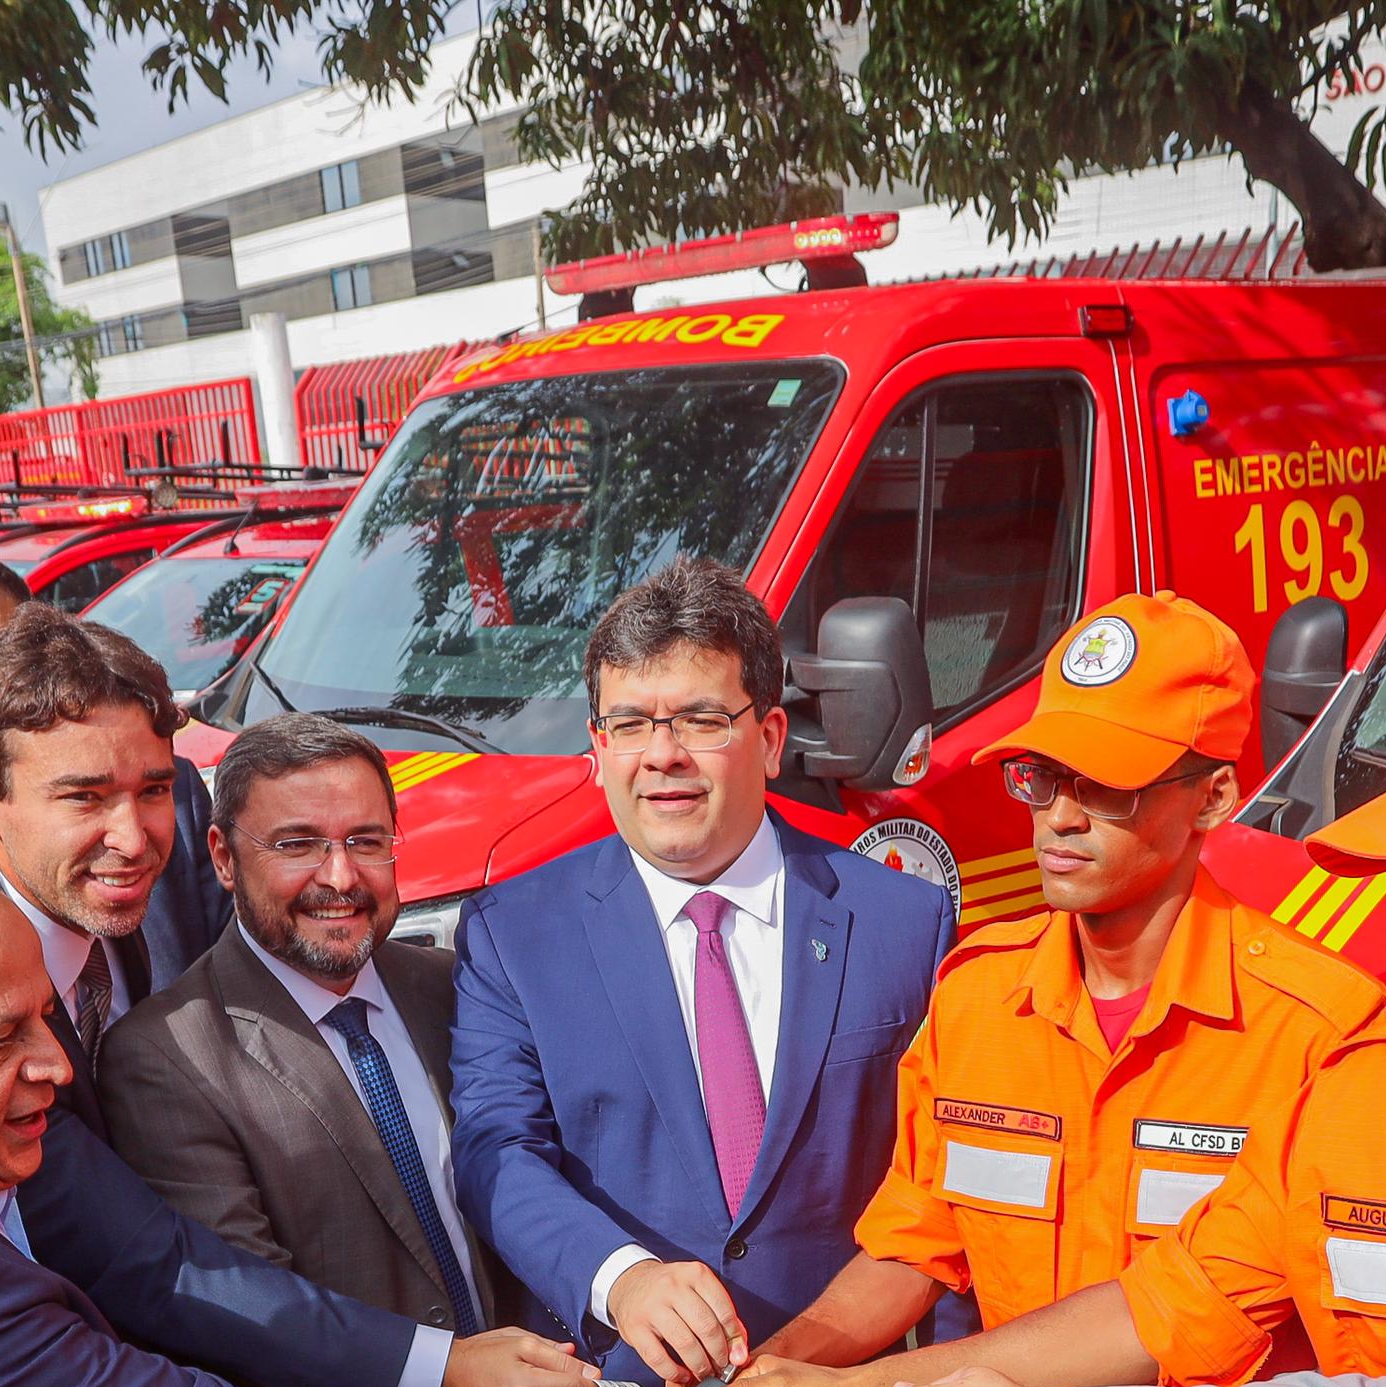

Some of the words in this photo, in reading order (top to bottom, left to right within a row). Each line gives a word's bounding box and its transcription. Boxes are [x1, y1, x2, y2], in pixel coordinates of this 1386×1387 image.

[1234, 494, 1369, 613] 193
[877, 821, 915, 840] MILITAR
[916, 826, 931, 842] DO
[928, 834, 954, 874] ESTADO
[948, 874, 958, 892] DO
[942, 1104, 1006, 1125] ALEXANDER
[1018, 1115, 1050, 1131] AB+
[1169, 1131, 1185, 1146] AL
[1191, 1133, 1226, 1150] CFSD
